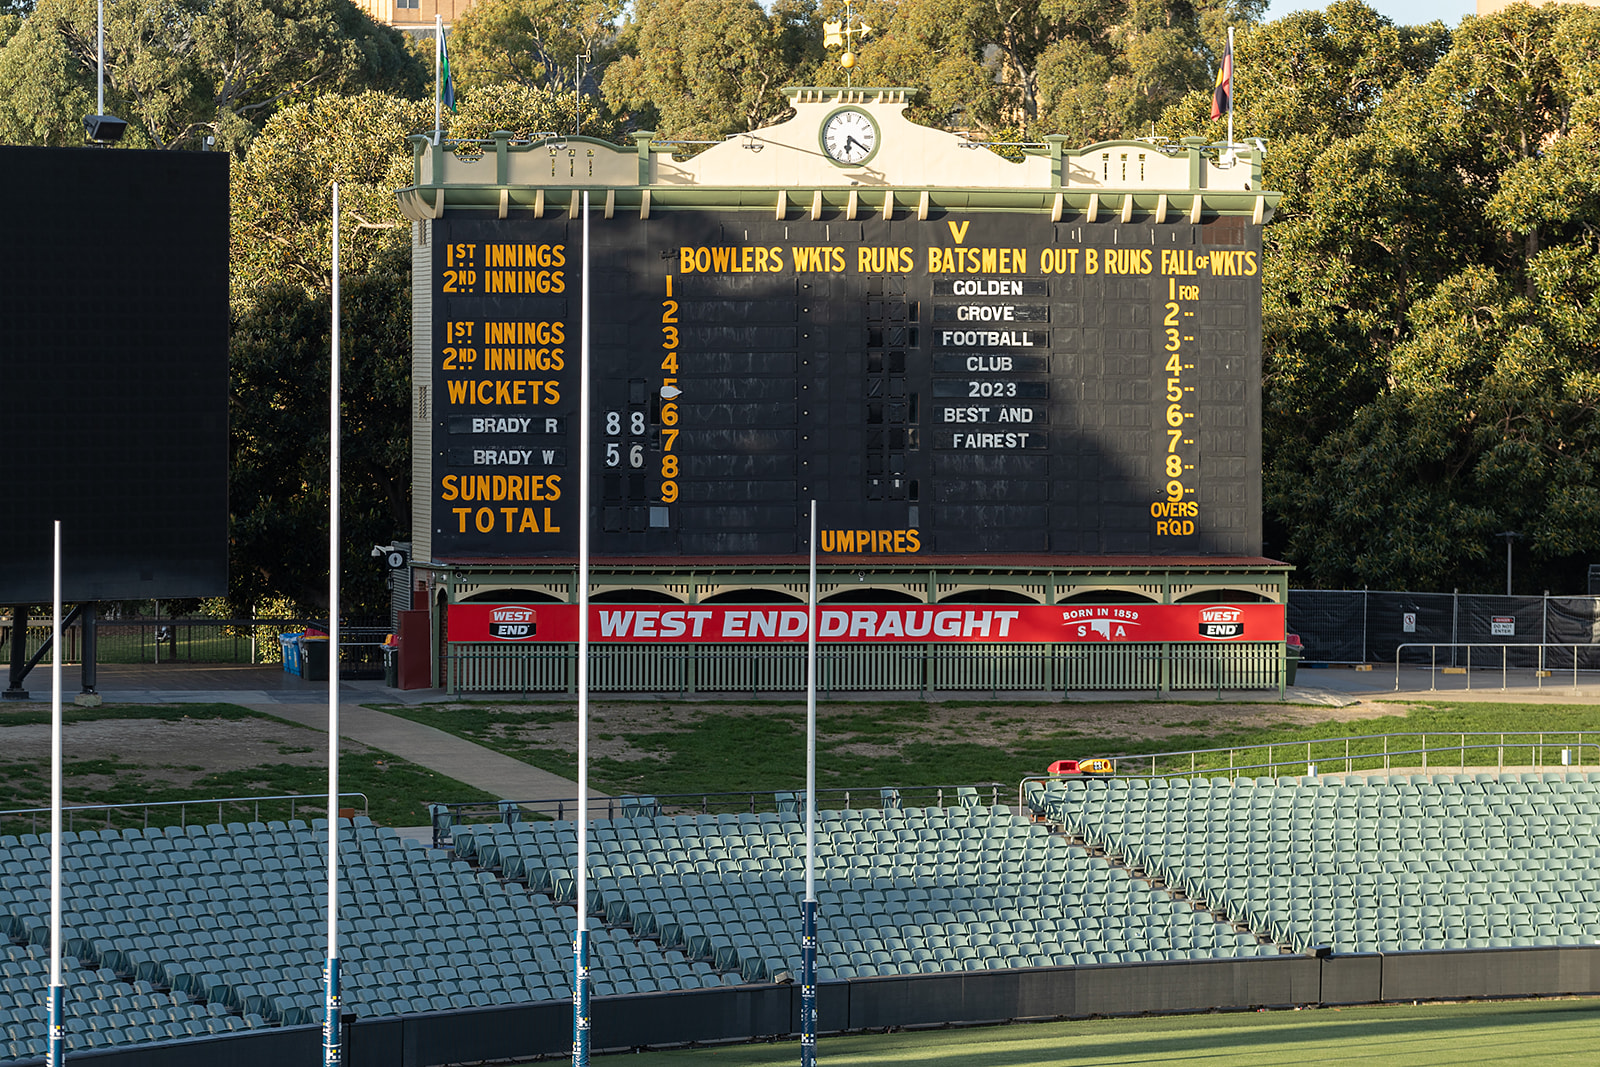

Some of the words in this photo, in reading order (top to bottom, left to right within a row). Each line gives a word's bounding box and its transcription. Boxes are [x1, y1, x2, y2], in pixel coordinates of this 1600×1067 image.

[948, 221, 970, 244] V
[485, 245, 565, 267] INNINGS
[680, 247, 783, 273] BOWLERS
[792, 247, 845, 272] WKTS
[858, 247, 914, 273] RUNS
[928, 247, 1026, 273] BATSMEN
[1040, 248, 1079, 274] OUT
[1085, 248, 1099, 274] B
[1104, 249, 1153, 275] RUNS
[1161, 249, 1196, 275] FALL
[1196, 256, 1209, 269] OF
[1209, 251, 1257, 276] WKTS
[485, 271, 565, 293] INNINGS
[666, 275, 672, 297] 1
[953, 281, 1023, 295] GOLDEN
[1169, 278, 1175, 300] 1
[1179, 285, 1200, 300] FOR
[663, 300, 678, 323] 2
[958, 306, 1014, 321] GROVE
[485, 322, 564, 345] INNINGS
[662, 326, 679, 349] 3
[943, 329, 1033, 346] FOOTBALL
[485, 348, 564, 370] INNINGS
[661, 352, 678, 374] 4
[967, 357, 1012, 371] CLUB
[448, 380, 560, 404] WICKETS
[969, 382, 1016, 397] 2023
[473, 418, 531, 432] BRADY
[546, 419, 557, 432] R
[662, 403, 678, 425] 6
[944, 408, 989, 422] BEST
[999, 408, 1032, 422] AND
[662, 429, 679, 451] 7
[954, 433, 1029, 448] FAIREST
[474, 450, 532, 464] BRADY
[543, 451, 554, 464] W
[662, 455, 678, 478] 8
[442, 475, 561, 501] SUNDRIES
[661, 481, 678, 503] 9
[453, 507, 560, 532] TOTAL
[1151, 501, 1198, 517] OVERS
[822, 529, 920, 552] UMPIRES
[494, 612, 532, 621] WEST
[599, 611, 712, 637] WEST
[722, 611, 807, 637] END
[819, 611, 1019, 636] DRAUGHT
[1063, 609, 1094, 620] BORN
[1097, 608, 1108, 616] IN
[1114, 609, 1138, 619] 1859
[1203, 612, 1240, 621] WEST
[498, 625, 528, 635] END
[1078, 626, 1086, 636] S
[1115, 626, 1126, 636] A
[1207, 625, 1236, 635] END
